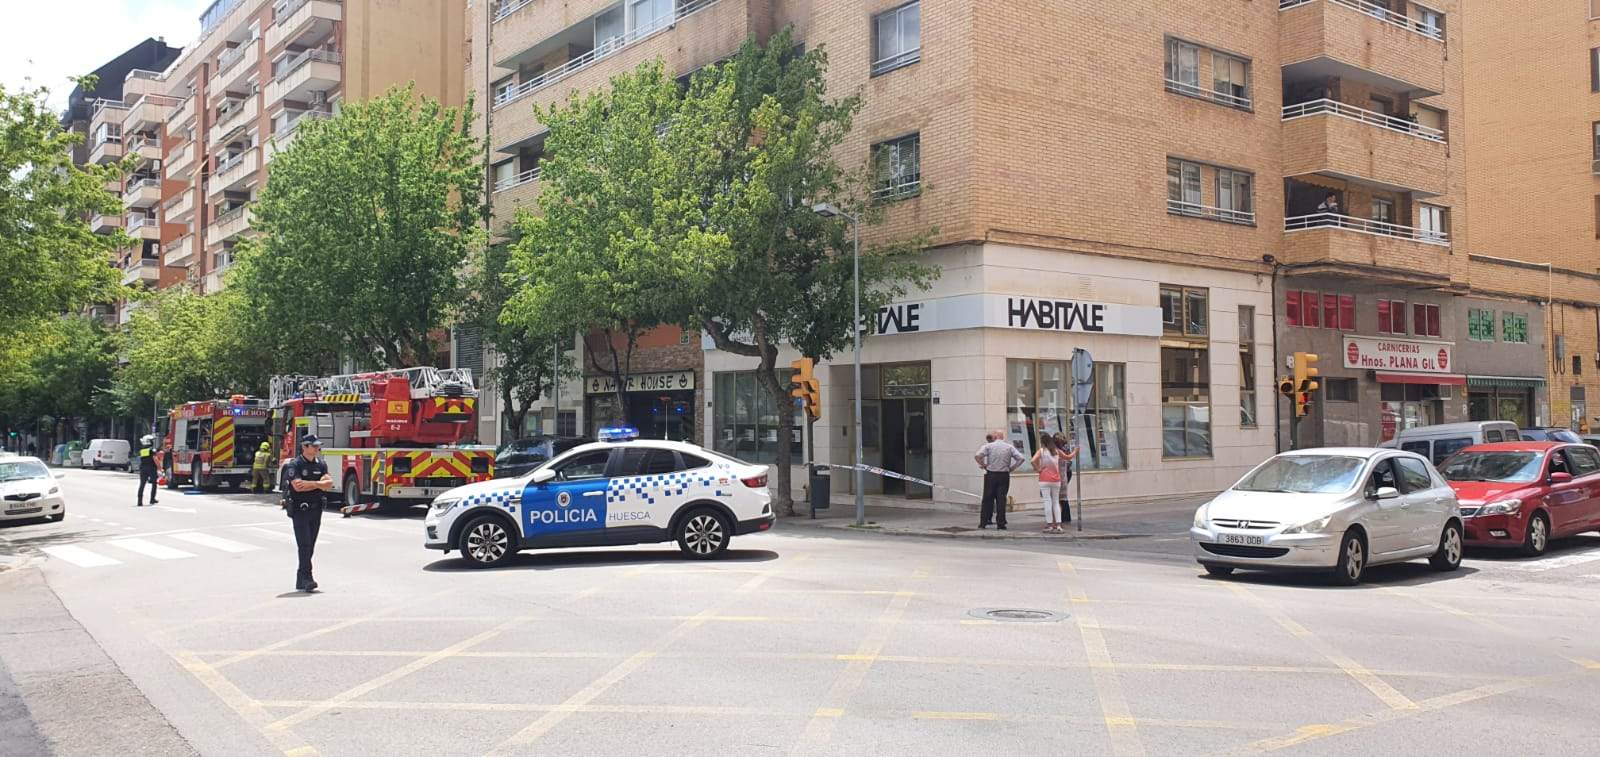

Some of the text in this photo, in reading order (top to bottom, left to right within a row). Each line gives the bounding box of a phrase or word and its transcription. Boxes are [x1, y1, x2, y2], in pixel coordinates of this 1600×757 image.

[1008, 297, 1104, 332] HABITALE
[1377, 342, 1421, 354] CARNICERIAS
[1361, 354, 1386, 368] Hnos.
[1389, 356, 1419, 369] PLANA
[1422, 358, 1436, 370] GIL
[603, 375, 674, 391] NAR HOUSE
[530, 508, 597, 524] POLICIA
[608, 511, 651, 521] HUESCA
